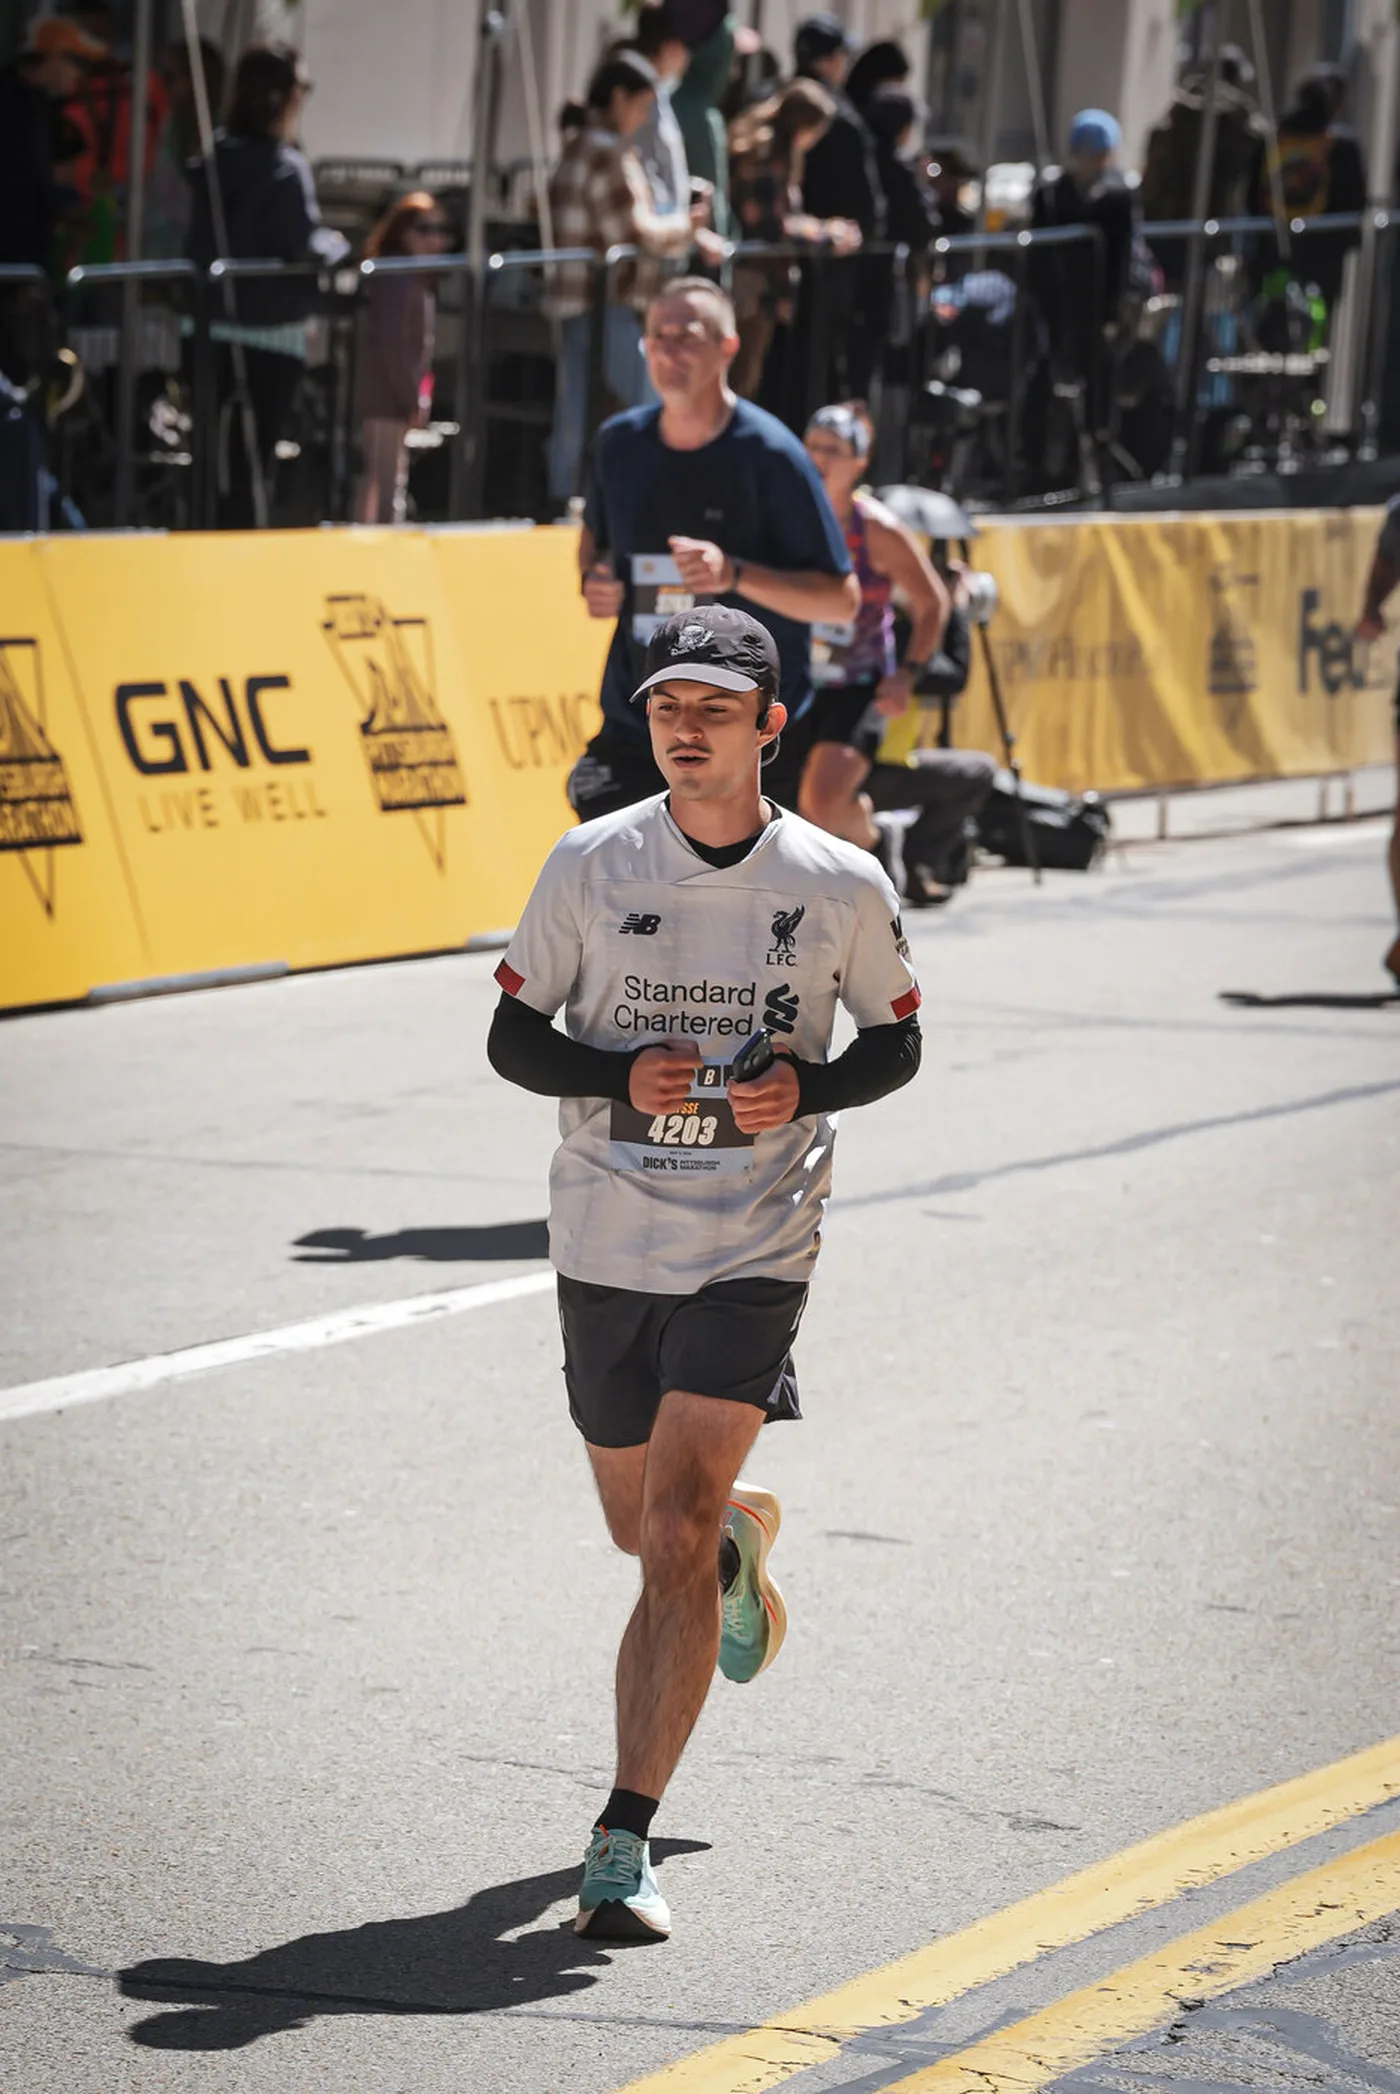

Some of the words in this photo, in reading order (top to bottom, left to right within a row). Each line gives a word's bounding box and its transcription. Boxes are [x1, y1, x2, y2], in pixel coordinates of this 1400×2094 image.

[115, 676, 310, 774] GNC
[137, 786, 220, 834] LIVE
[230, 779, 329, 823] WELL
[624, 975, 756, 1006] Standard
[613, 1005, 753, 1036] Chartered
[704, 1069, 716, 1085] B
[648, 1114, 718, 1145] 4203
[642, 1156, 678, 1170] DICK'S
